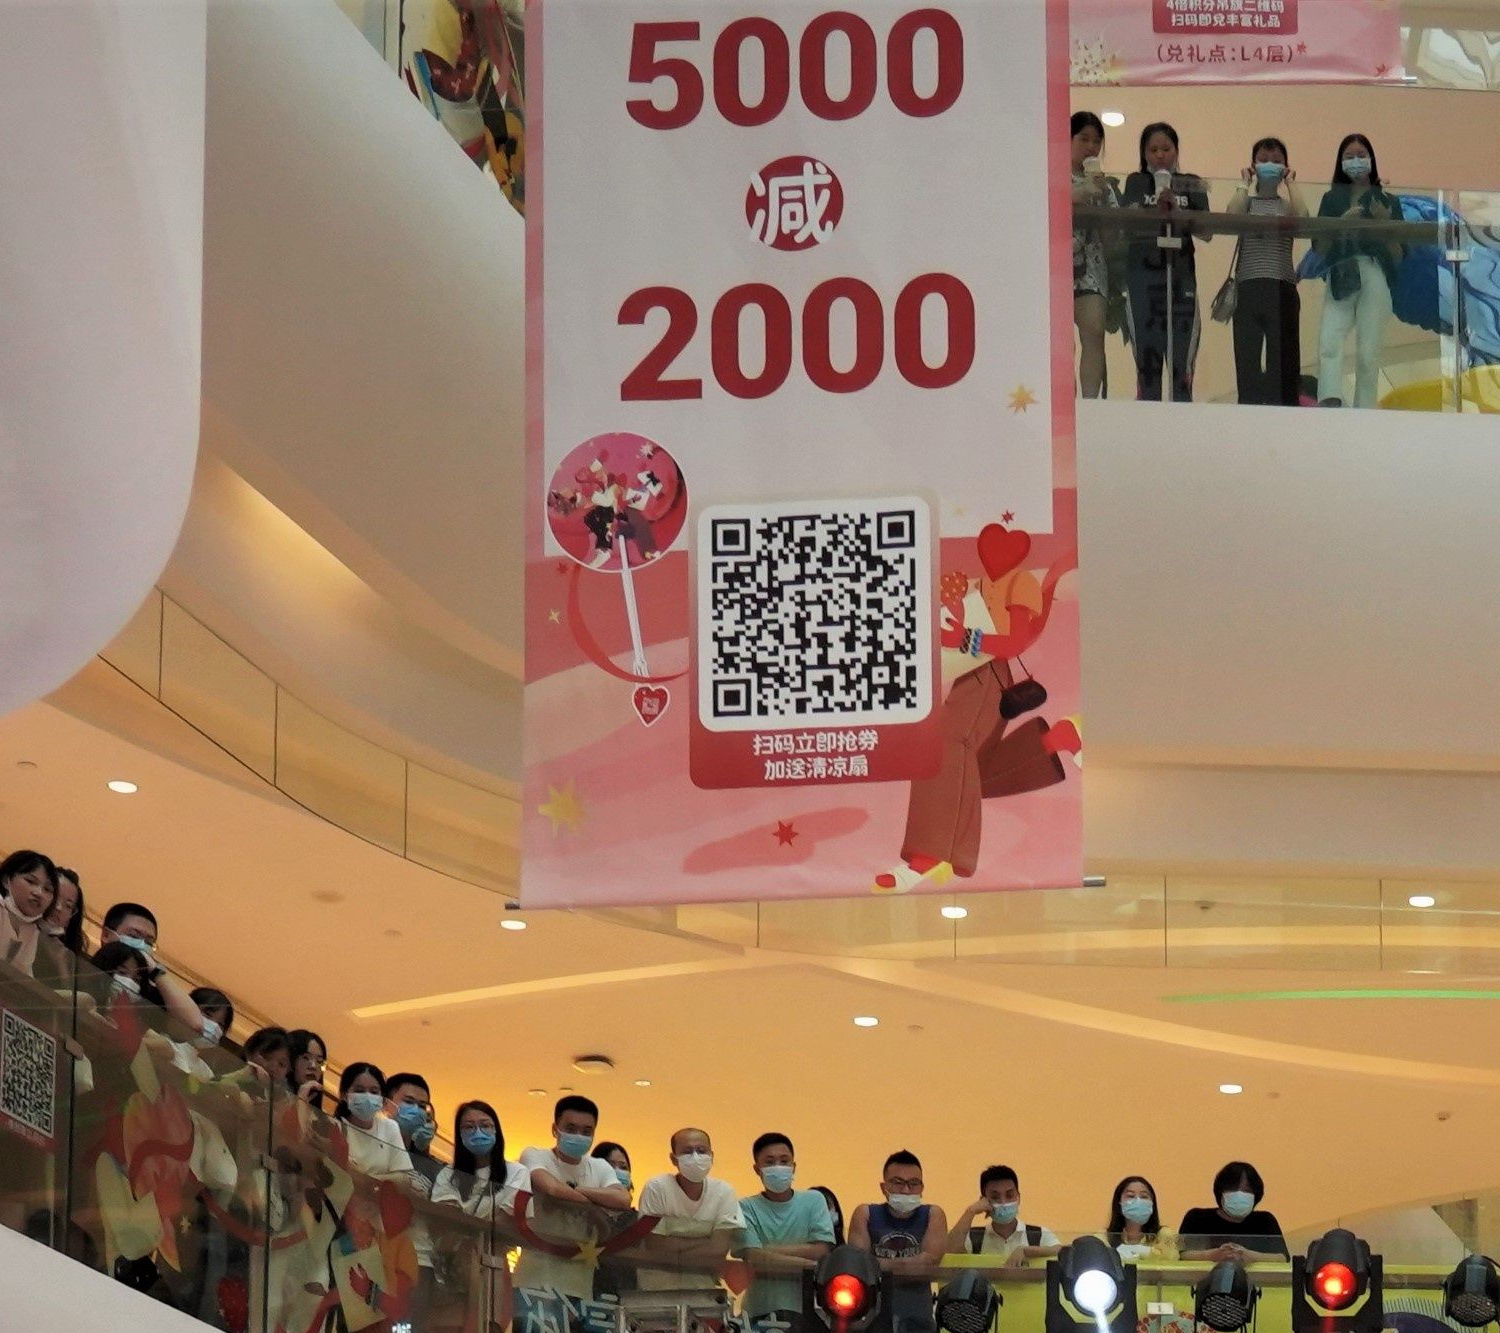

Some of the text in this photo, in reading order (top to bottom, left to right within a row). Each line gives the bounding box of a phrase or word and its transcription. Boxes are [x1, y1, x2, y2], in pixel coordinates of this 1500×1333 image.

[625, 8, 965, 131] 5000
[749, 160, 835, 247] 减
[616, 272, 977, 402] 2000
[764, 754, 869, 781] 加送清凉扇
